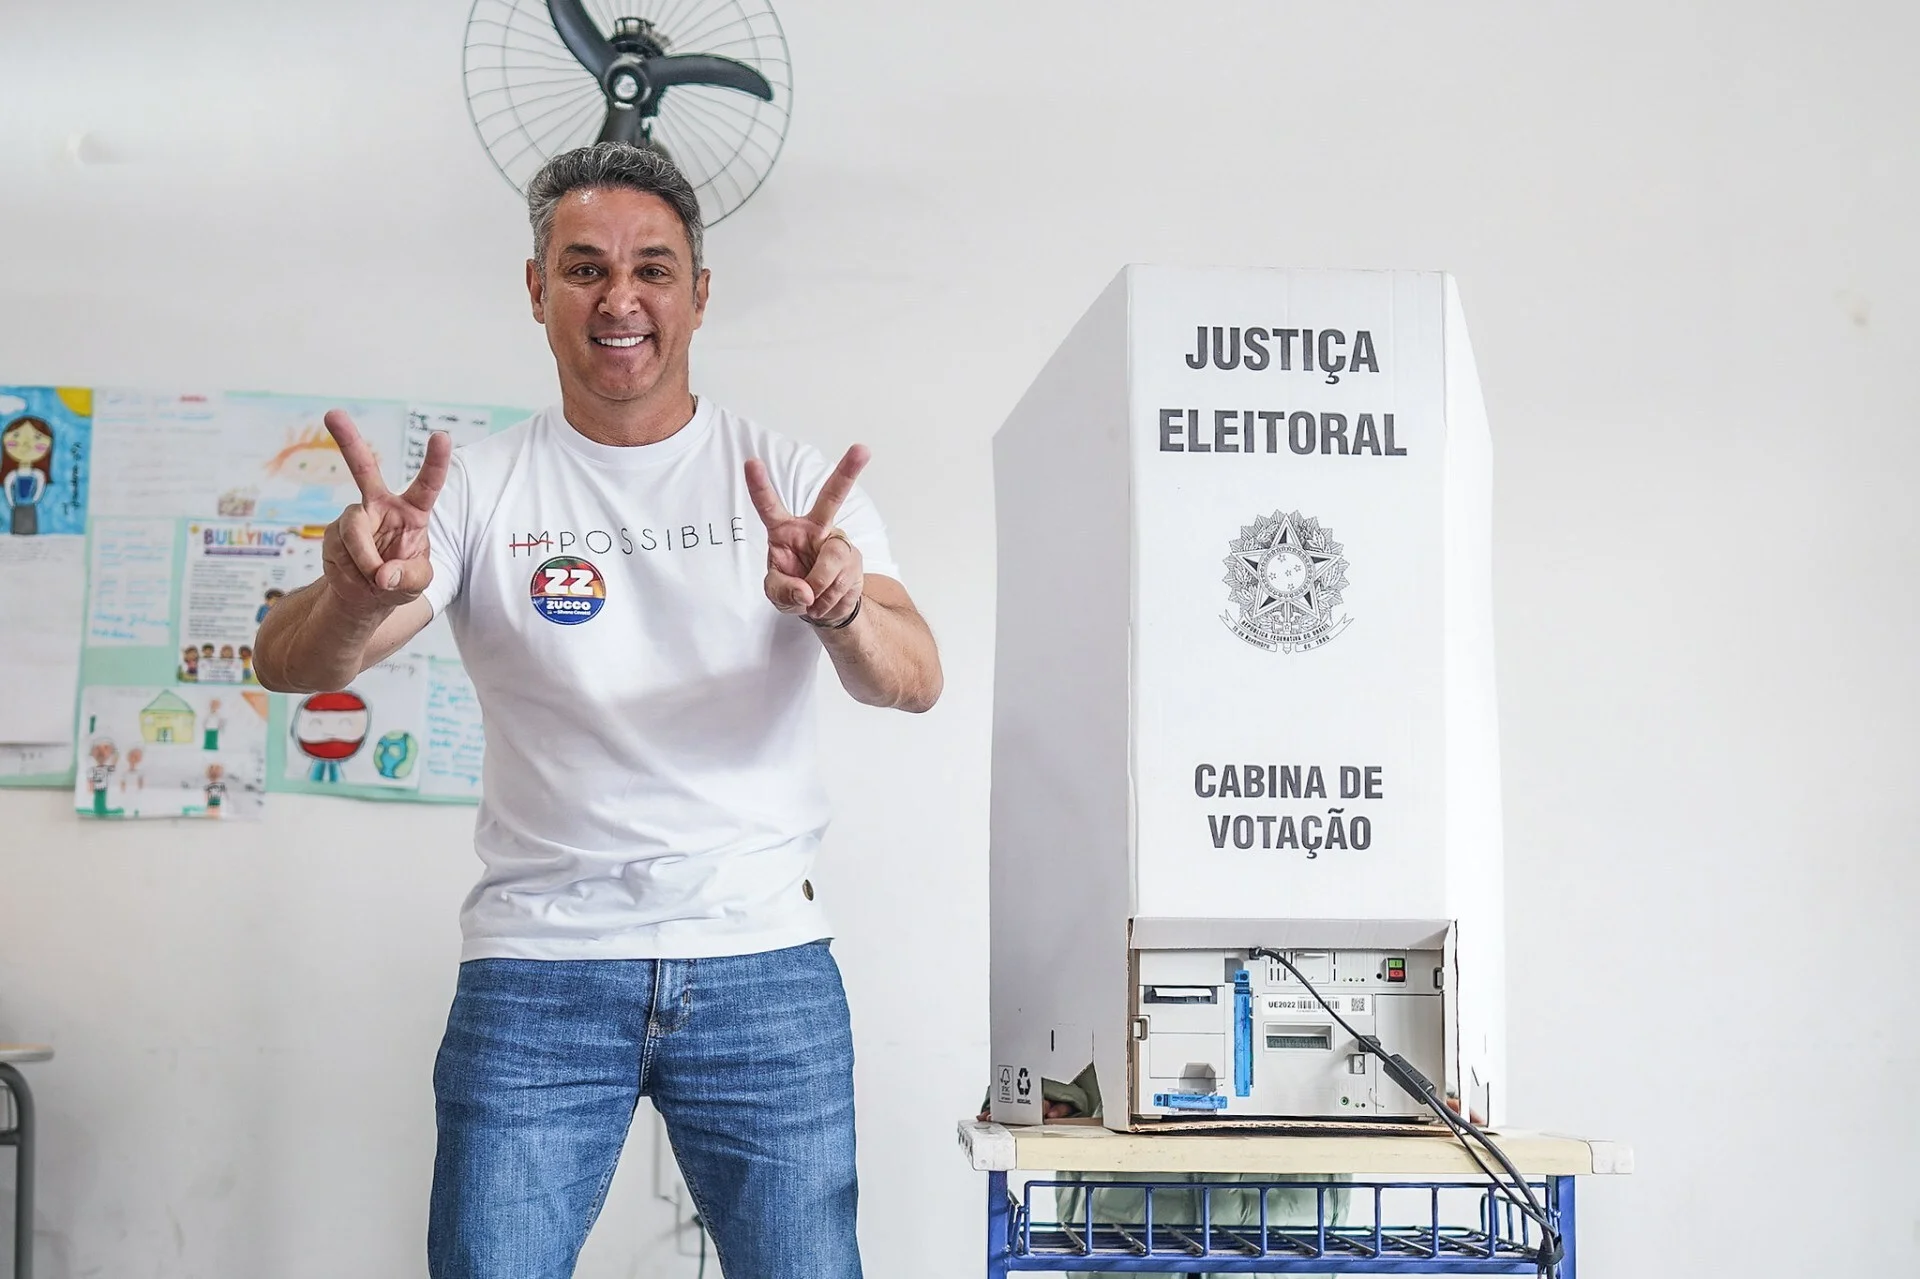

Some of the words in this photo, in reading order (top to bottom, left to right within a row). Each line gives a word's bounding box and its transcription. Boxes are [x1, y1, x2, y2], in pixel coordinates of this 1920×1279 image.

[1185, 326, 1380, 385] JUSTIÇA
[1159, 408, 1408, 457] ELEITORAL
[203, 527, 286, 547] BULLYING
[545, 569, 594, 595] 22
[547, 601, 591, 610] ZUCCO
[1194, 764, 1327, 799] CABINA
[1340, 766, 1383, 799] DE
[1207, 807, 1372, 859] VOTAÇÃO
[1268, 1001, 1296, 1009] UE2022
